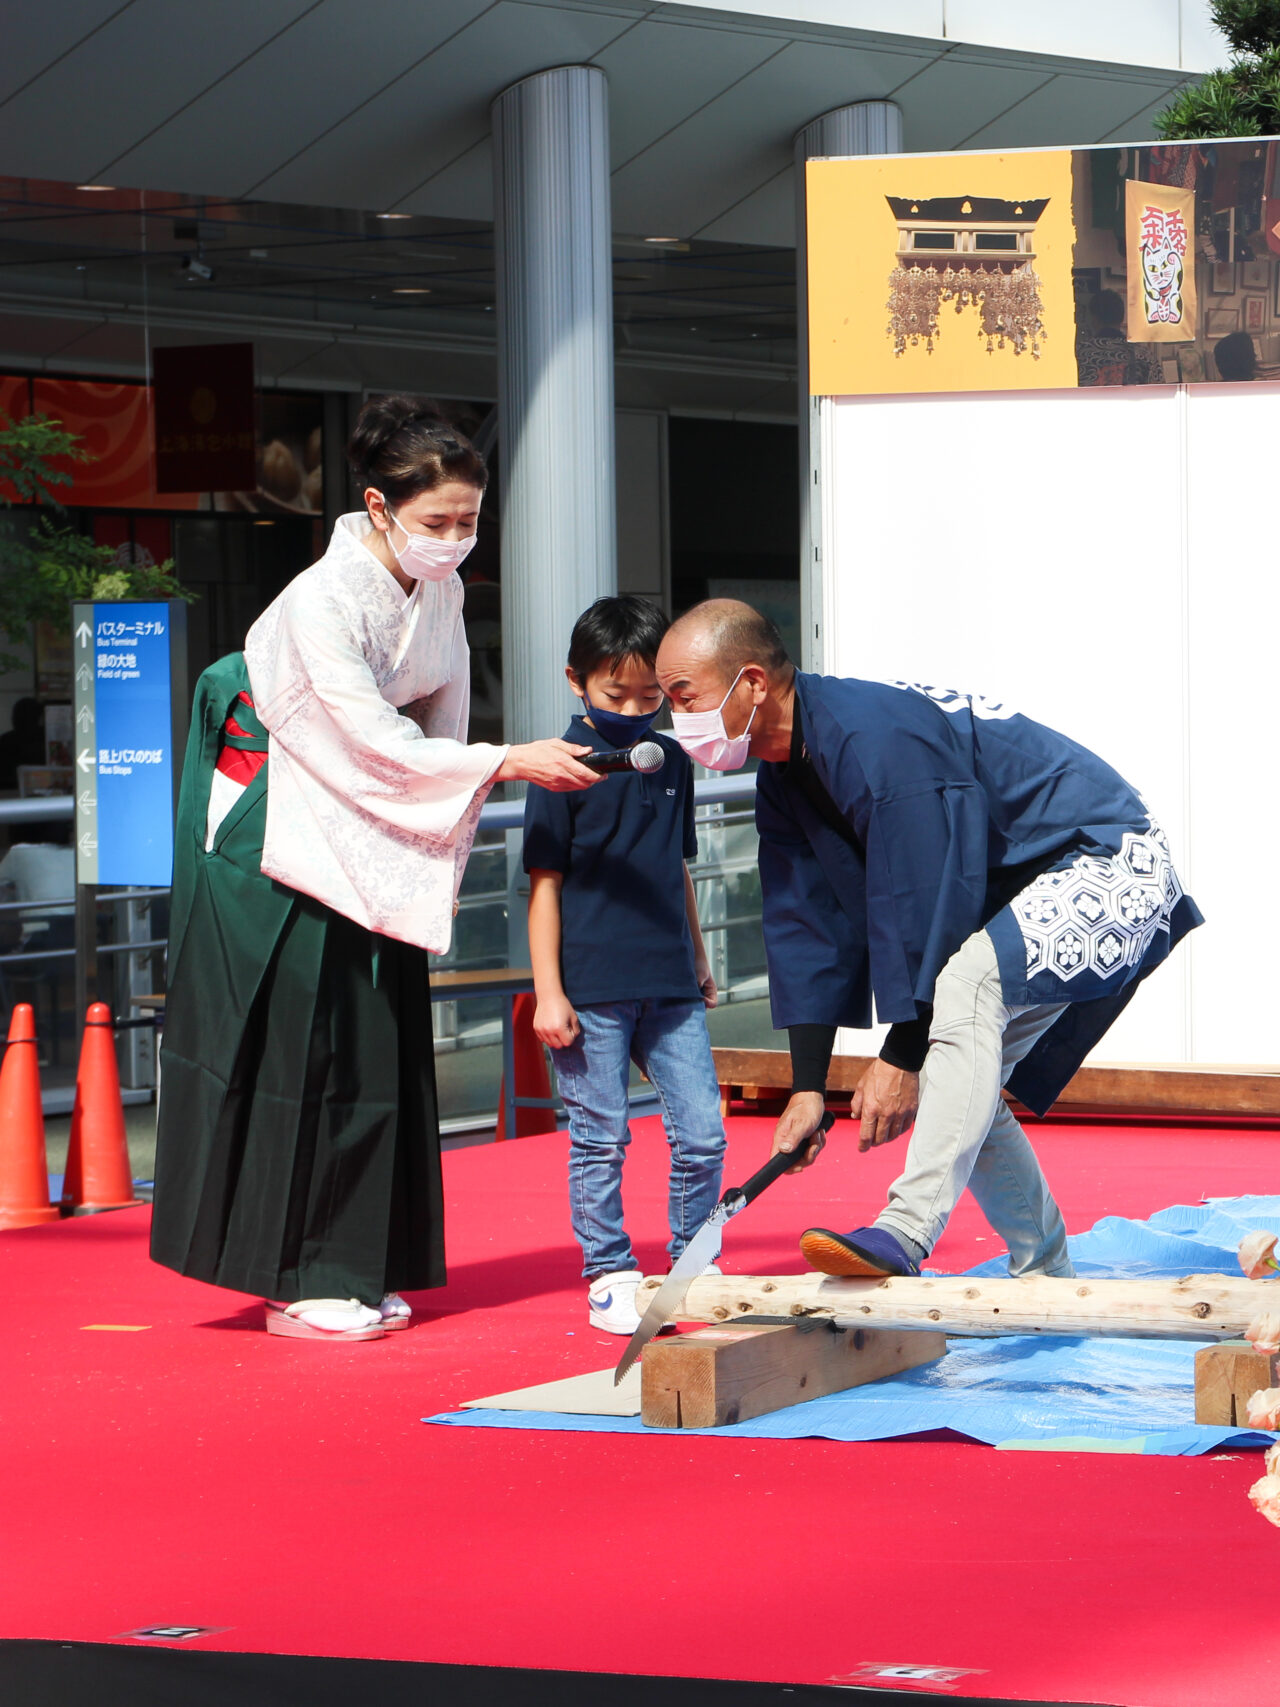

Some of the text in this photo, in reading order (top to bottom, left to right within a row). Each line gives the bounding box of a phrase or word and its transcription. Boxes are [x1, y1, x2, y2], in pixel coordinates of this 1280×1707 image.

[97, 621, 165, 636] バスターミナル
[97, 637, 138, 647] Bus Terminal
[97, 653, 137, 668] 緑の大地
[97, 669, 140, 681] Field of green
[98, 749, 163, 764] 路上バスのりば
[99, 764, 133, 776] Bus Stops
